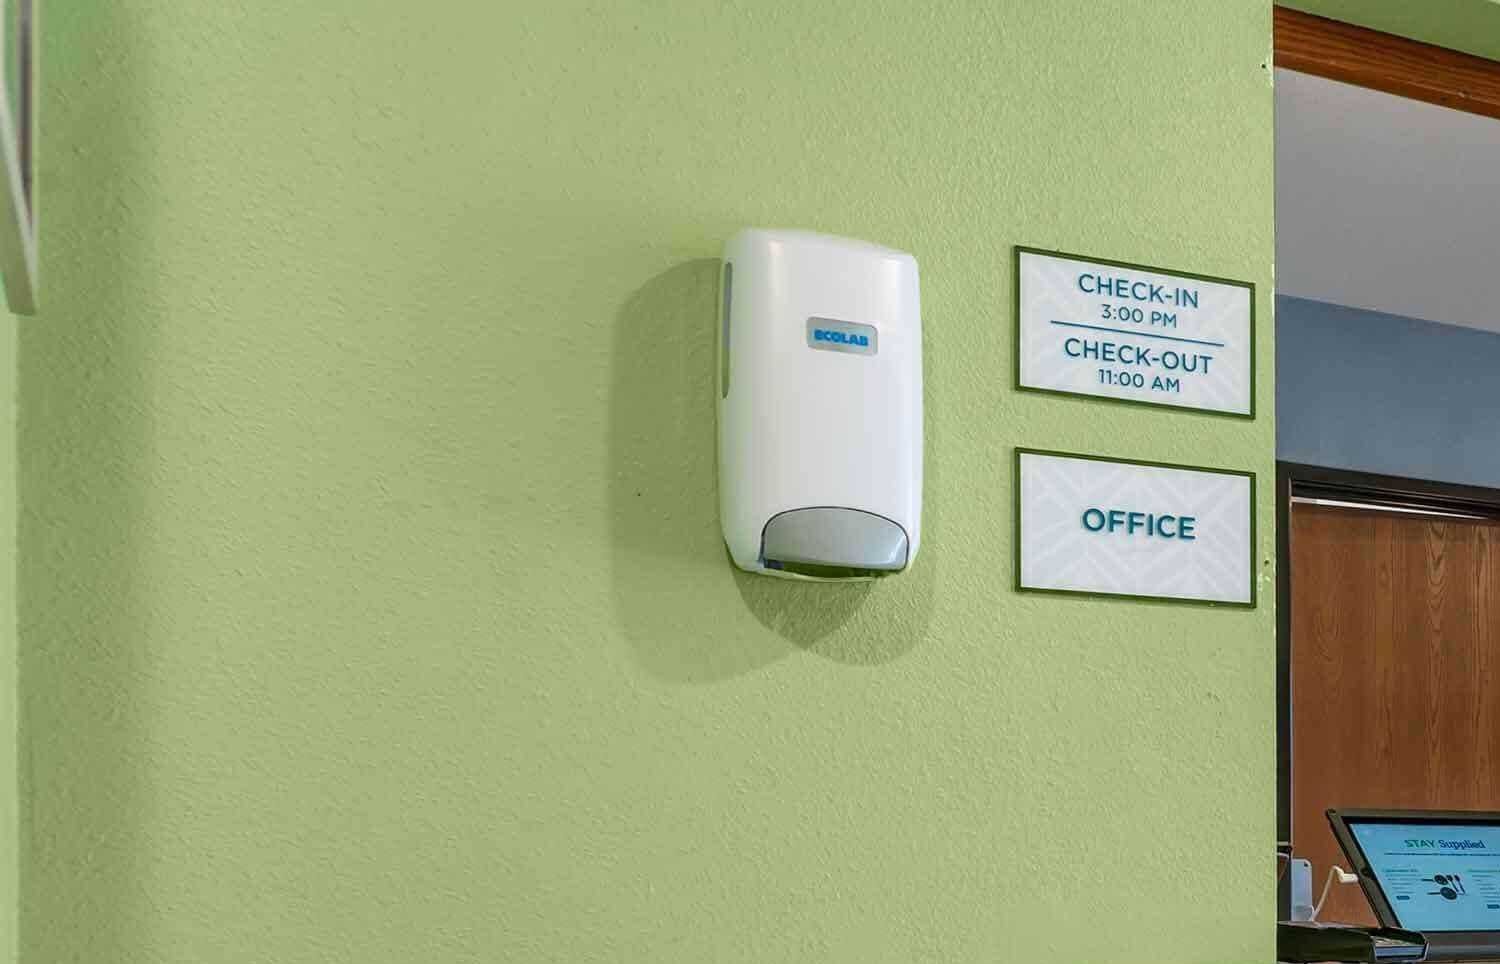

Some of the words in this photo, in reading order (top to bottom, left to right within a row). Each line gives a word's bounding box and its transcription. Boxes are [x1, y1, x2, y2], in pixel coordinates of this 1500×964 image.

[1078, 273, 1199, 308] CHECK-IN
[1101, 303, 1144, 324] 3:00
[1151, 309, 1178, 329] PM
[814, 329, 869, 347] ECOLAB
[1064, 337, 1213, 374] CHECK-OUT
[1099, 369, 1145, 388] 11:00
[1151, 375, 1180, 393] AM
[1082, 507, 1197, 540] OFFICE
[1405, 839, 1435, 848] STAY
[1439, 839, 1486, 851] Supplied
